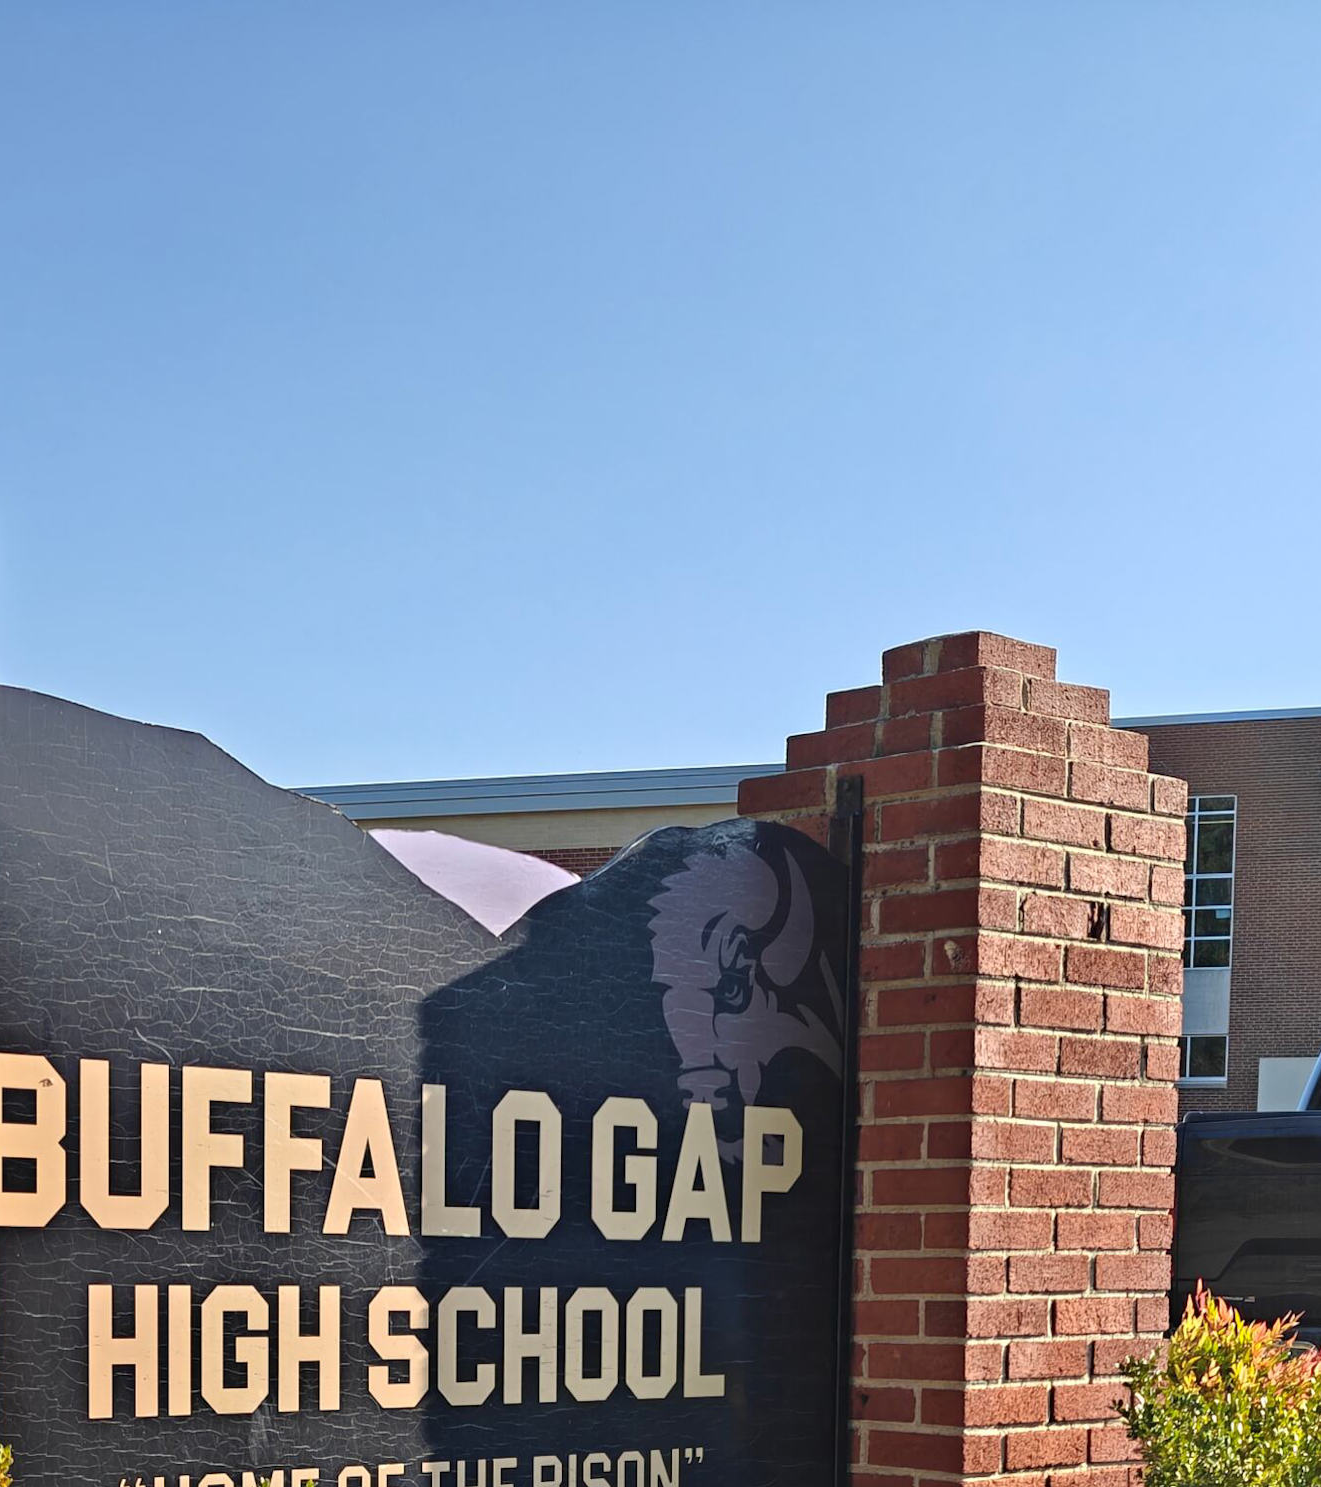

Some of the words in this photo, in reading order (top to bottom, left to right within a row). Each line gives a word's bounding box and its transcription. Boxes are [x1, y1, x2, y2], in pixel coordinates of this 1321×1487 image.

[592, 1096, 804, 1243] GAP
[88, 1284, 341, 1419] HIGH
[368, 1285, 725, 1410] SCHOOL
